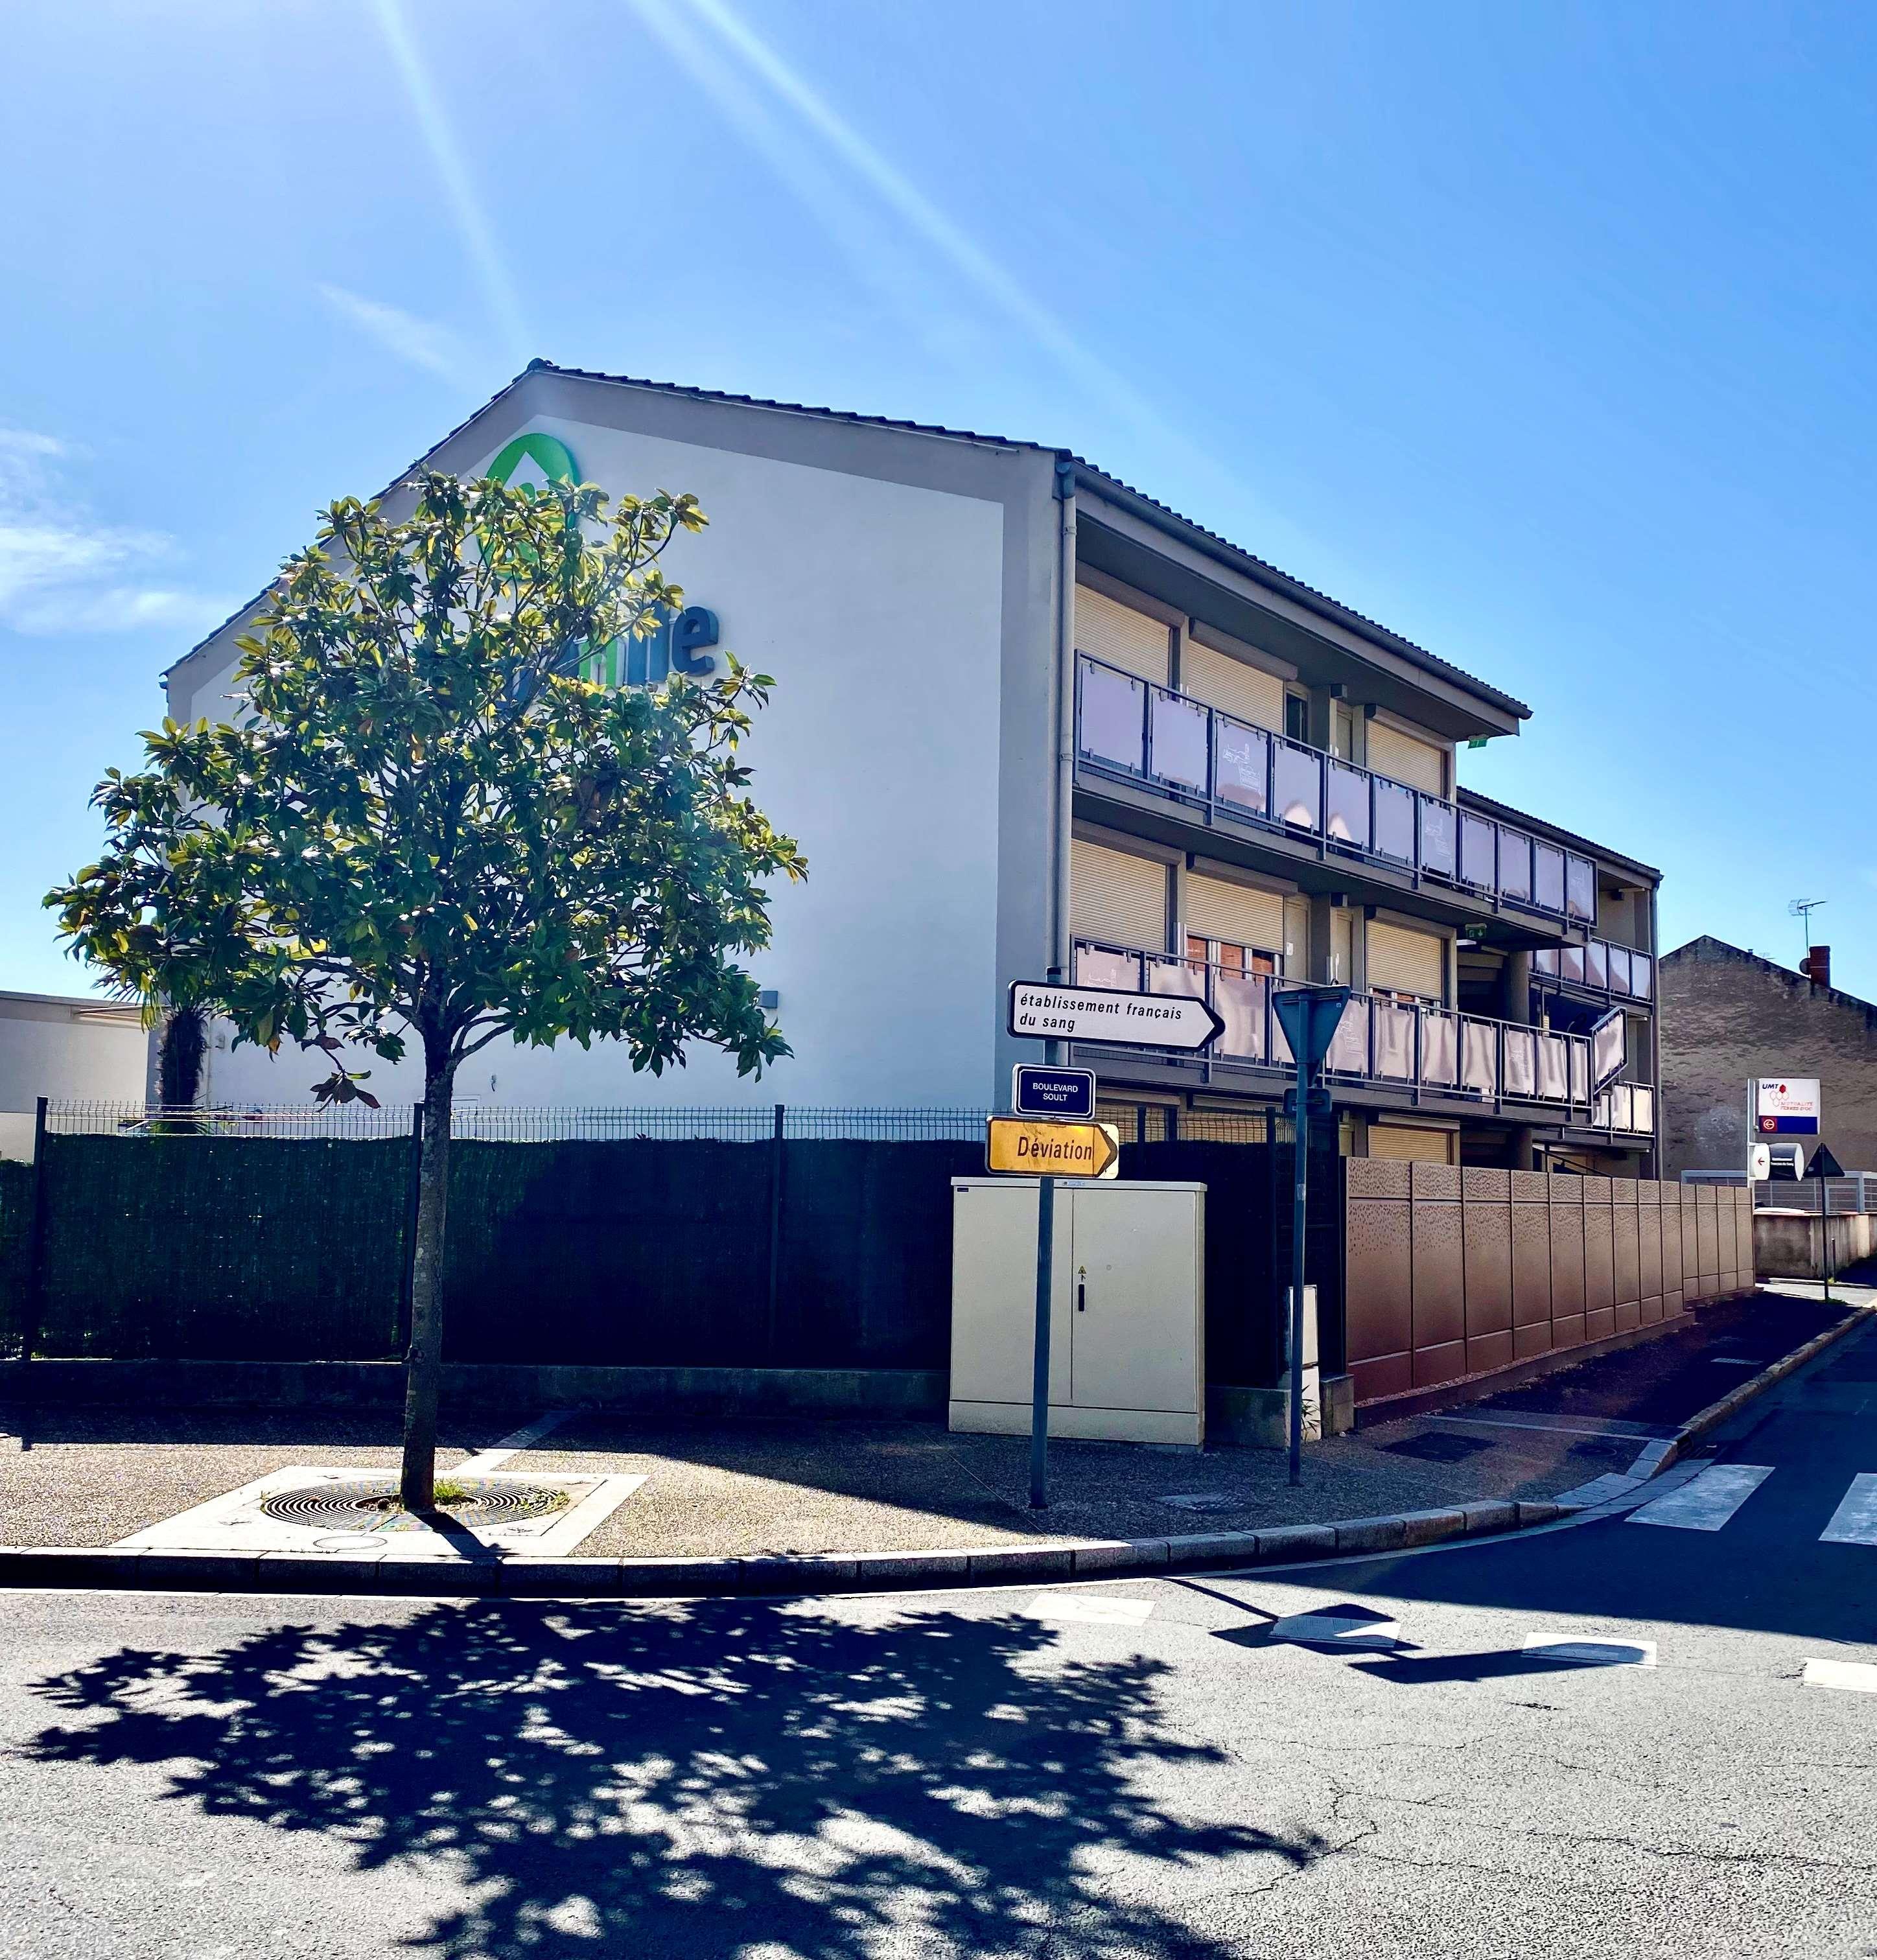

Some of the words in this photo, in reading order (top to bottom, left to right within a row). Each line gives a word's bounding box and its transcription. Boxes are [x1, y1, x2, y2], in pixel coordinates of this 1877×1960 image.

[1020, 993, 1120, 1014] établissement
[1126, 1003, 1182, 1020] français
[1020, 1013, 1036, 1026] du
[1042, 1018, 1076, 1033] sang
[1032, 1082, 1078, 1093] BOULEVARD
[1043, 1093, 1068, 1101] SOULT
[1017, 1136, 1092, 1160] Déviation
